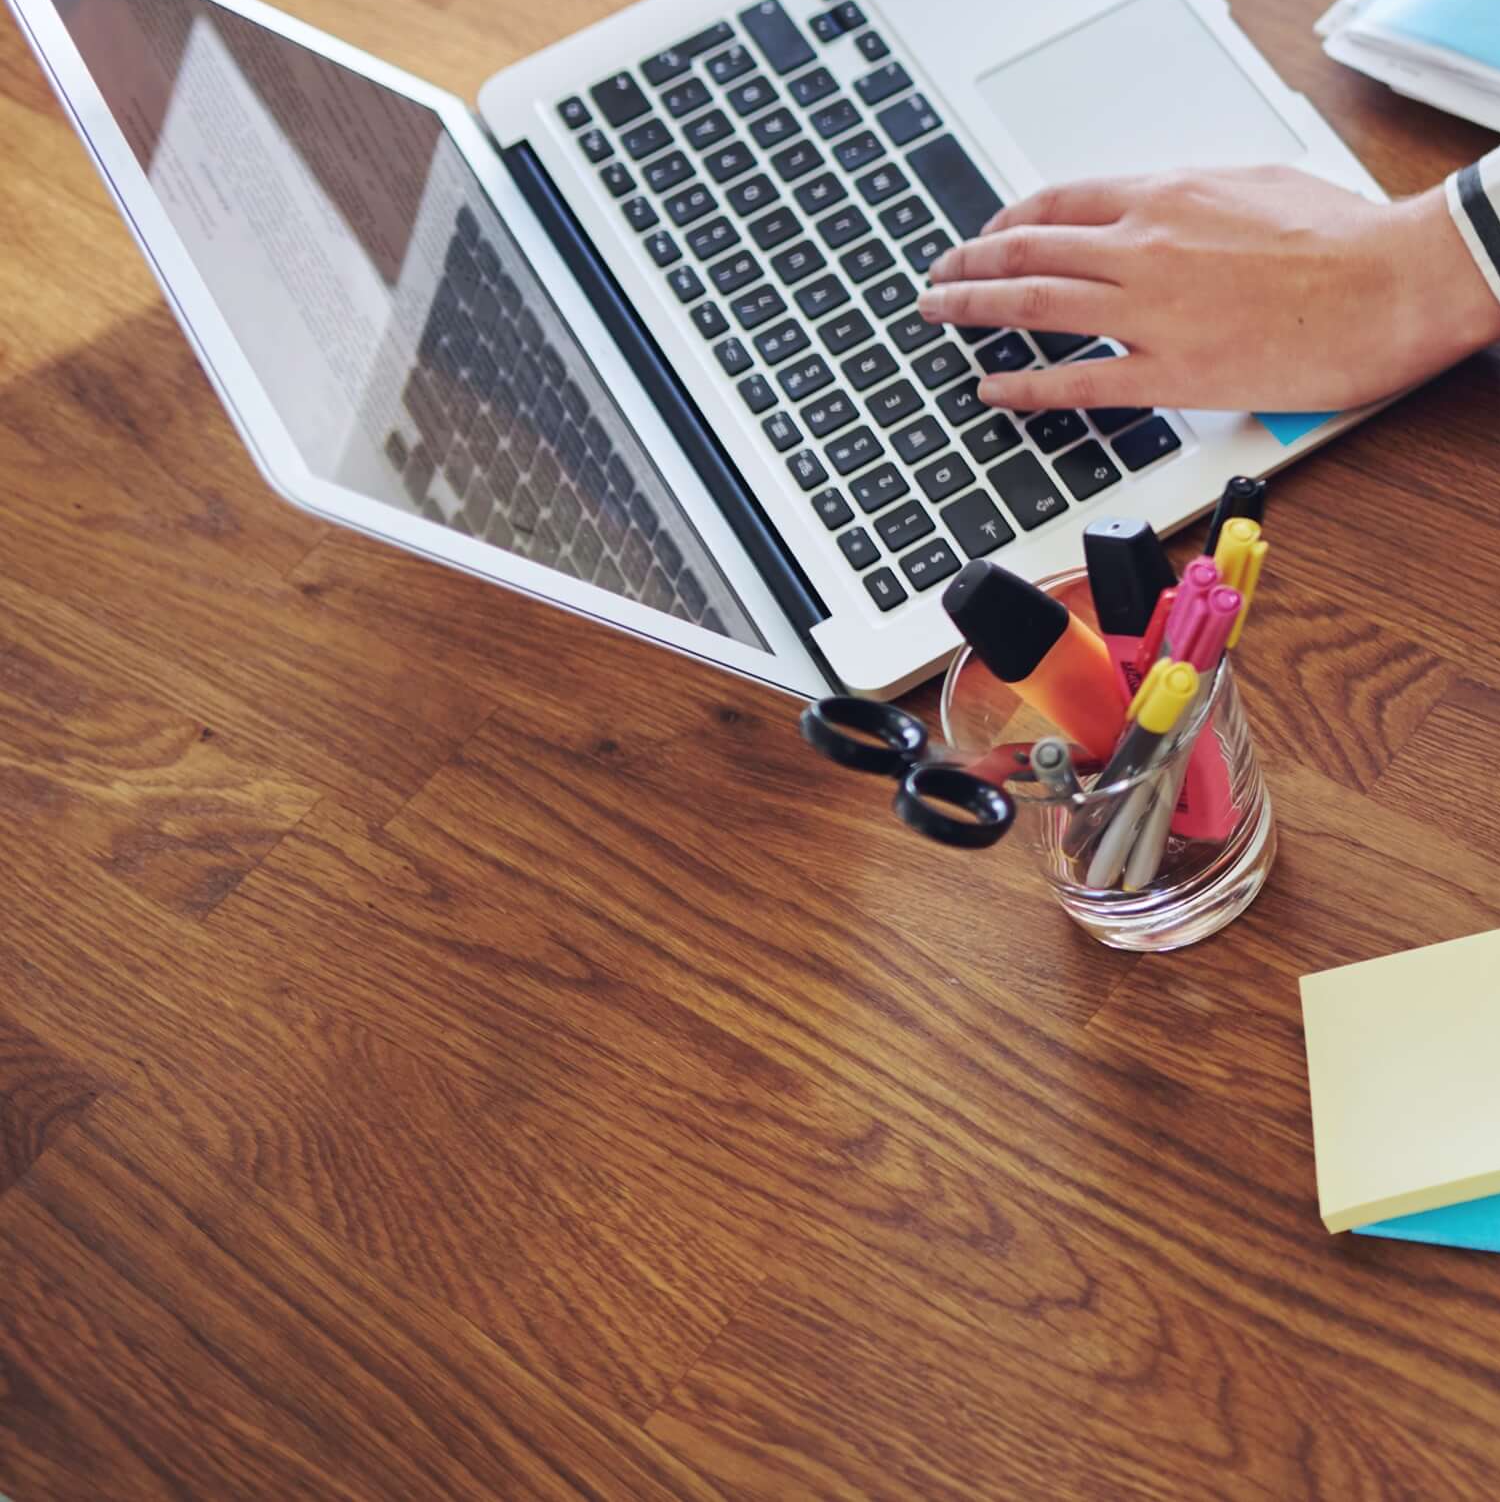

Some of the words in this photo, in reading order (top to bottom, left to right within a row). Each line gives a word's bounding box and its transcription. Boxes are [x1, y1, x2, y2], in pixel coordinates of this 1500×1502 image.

[813, 186, 826, 198] K
[790, 254, 805, 268] U
[860, 253, 873, 266] H
[813, 290, 826, 303] Y
[882, 287, 898, 301] G
[783, 330, 796, 341] 6
[836, 326, 851, 337] T
[906, 325, 921, 336] F
[862, 359, 876, 372] R
[932, 358, 947, 372] D
[806, 366, 820, 378] 5
[885, 396, 901, 408] E
[957, 394, 972, 406] S
[830, 402, 842, 412] 4
[910, 431, 926, 448] W
[984, 430, 997, 442] A
[854, 438, 868, 451] 3
[936, 468, 951, 483] Q
[879, 476, 893, 488] 2
